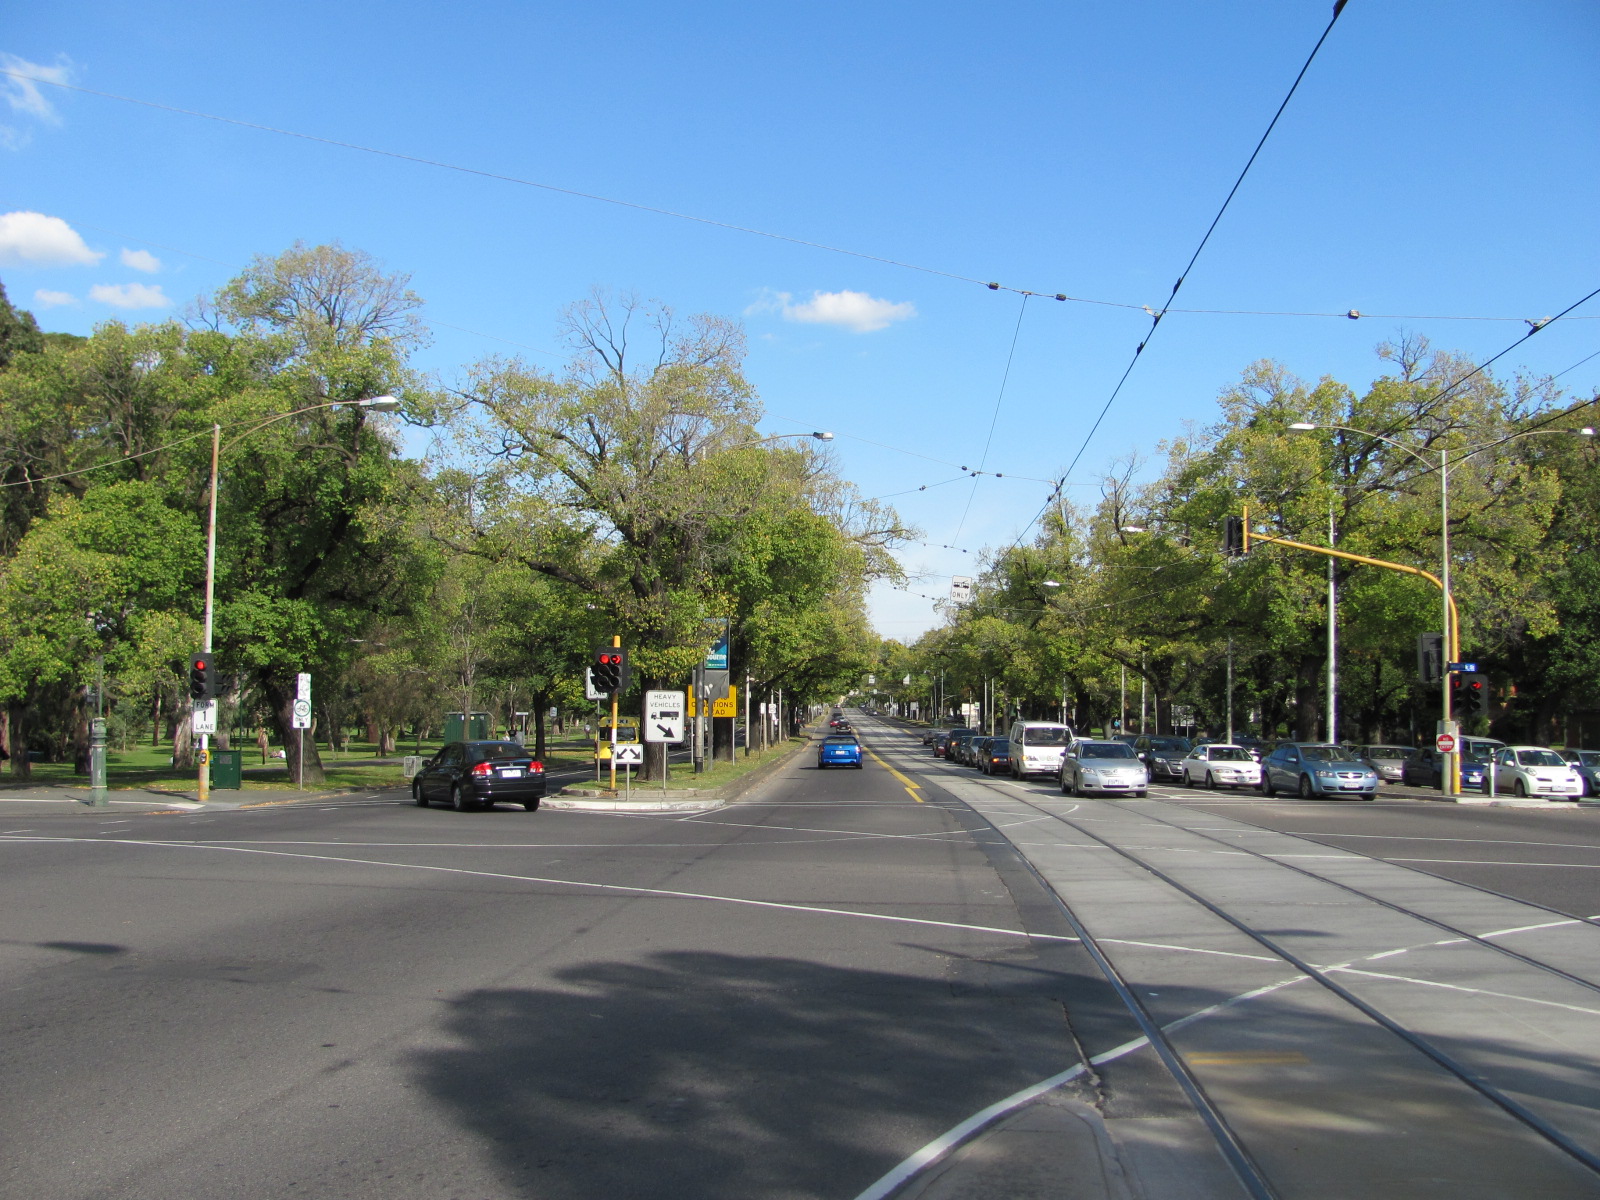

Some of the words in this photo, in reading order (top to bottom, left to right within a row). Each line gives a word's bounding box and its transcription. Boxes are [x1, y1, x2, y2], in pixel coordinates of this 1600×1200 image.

[952, 591, 968, 599] ONLY
[195, 701, 215, 709] FORM
[202, 710, 207, 722] 1
